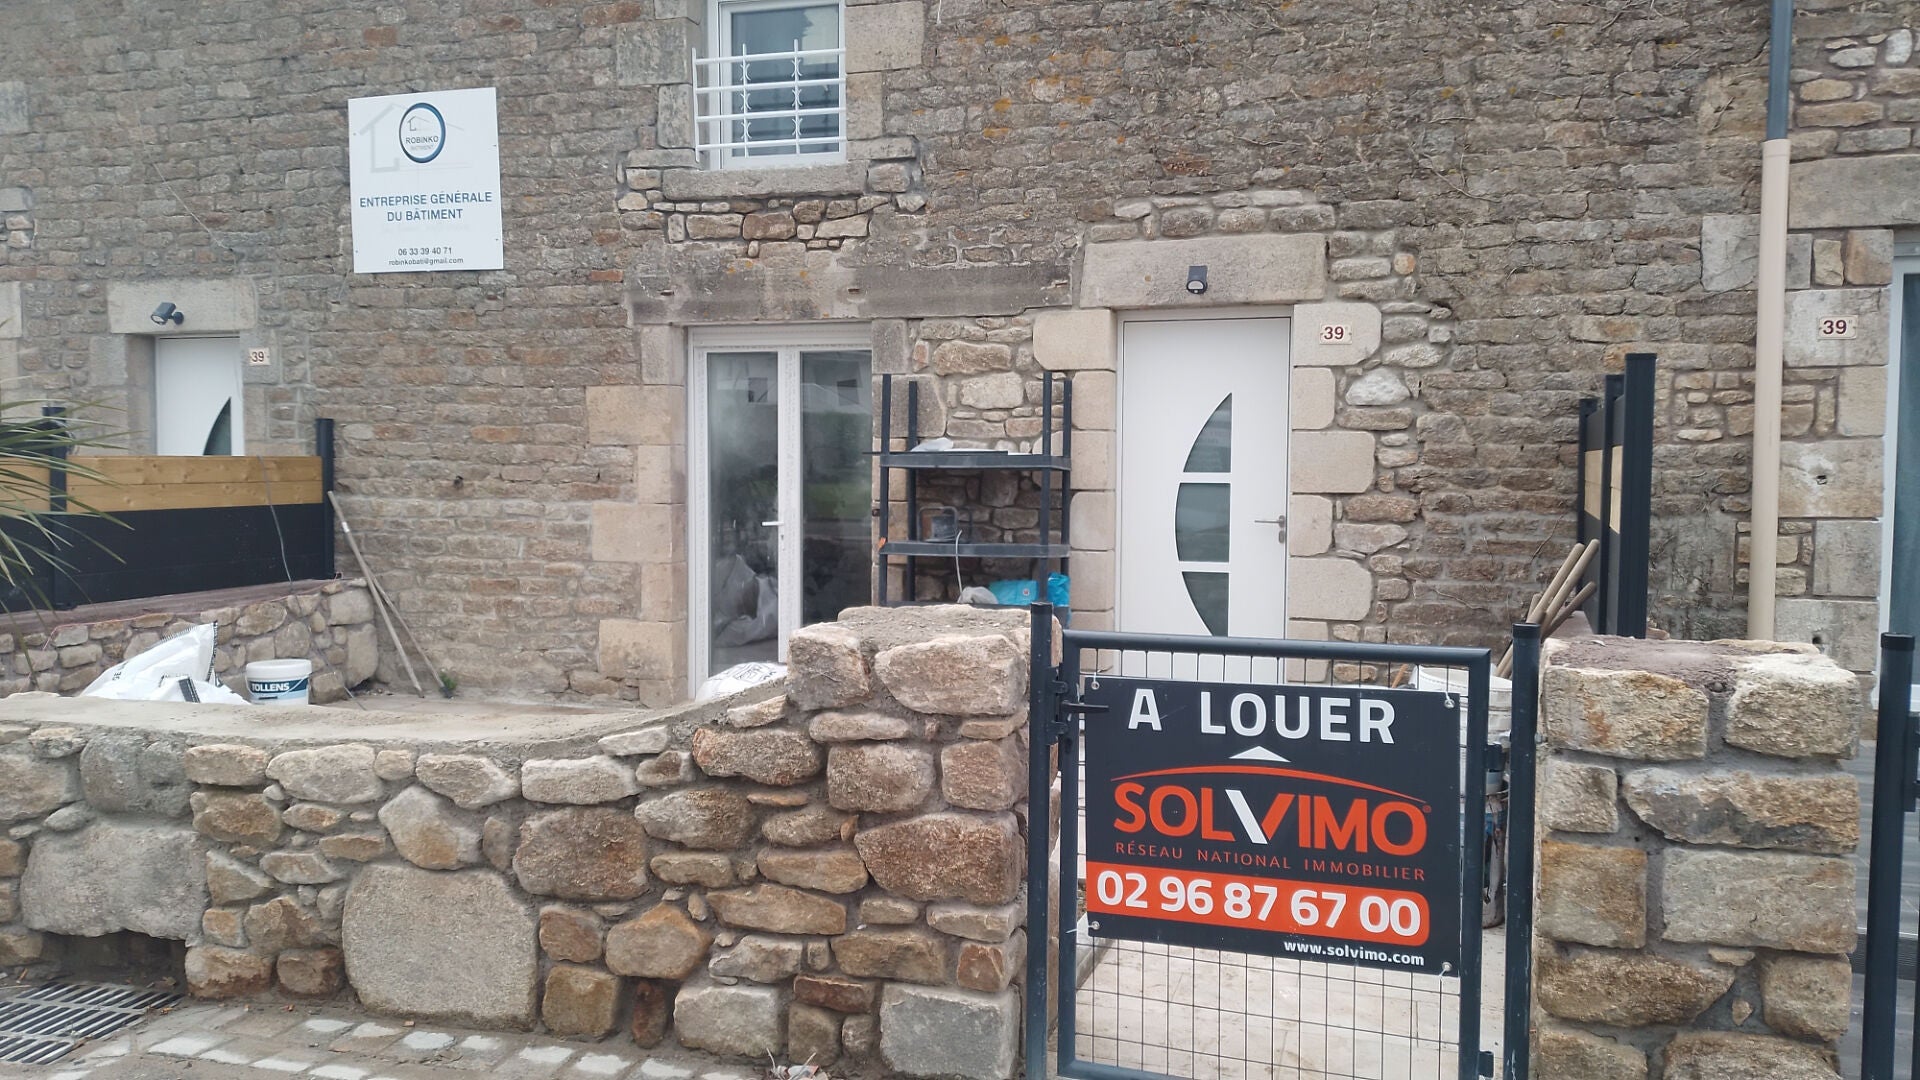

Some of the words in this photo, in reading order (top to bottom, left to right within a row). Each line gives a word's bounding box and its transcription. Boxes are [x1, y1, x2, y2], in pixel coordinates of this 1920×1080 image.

[405, 136, 439, 144] ROBINKO
[359, 194, 427, 208] ENTREPRISE
[430, 189, 493, 205] GÉNÉRALE
[387, 211, 403, 222] DU
[405, 207, 464, 221] BÂTIMENT
[397, 248, 408, 256] 06
[409, 248, 419, 256] 33
[420, 247, 430, 255] 39
[432, 247, 442, 255] 40
[443, 246, 453, 254] 71
[388, 257, 464, 265] robinkobati@gmail.com
[1323, 326, 1344, 340] 39
[1823, 319, 1848, 335] 39
[251, 351, 265, 362] 39
[251, 683, 290, 692] TOLLENS
[1128, 688, 1162, 731] A
[1200, 691, 1395, 744] LOUER
[1113, 782, 1428, 857] SOLVIMO
[1115, 841, 1183, 860] RÉSEAU
[1197, 850, 1291, 869] NATIONAL
[1303, 859, 1426, 882] IMMOBILIER
[1097, 870, 1148, 909] 02
[1159, 876, 1214, 915] 96
[1224, 882, 1278, 922] 87
[1290, 889, 1347, 929] 67
[1359, 895, 1421, 937] 00
[1283, 940, 1425, 967] www.solvimo.com
